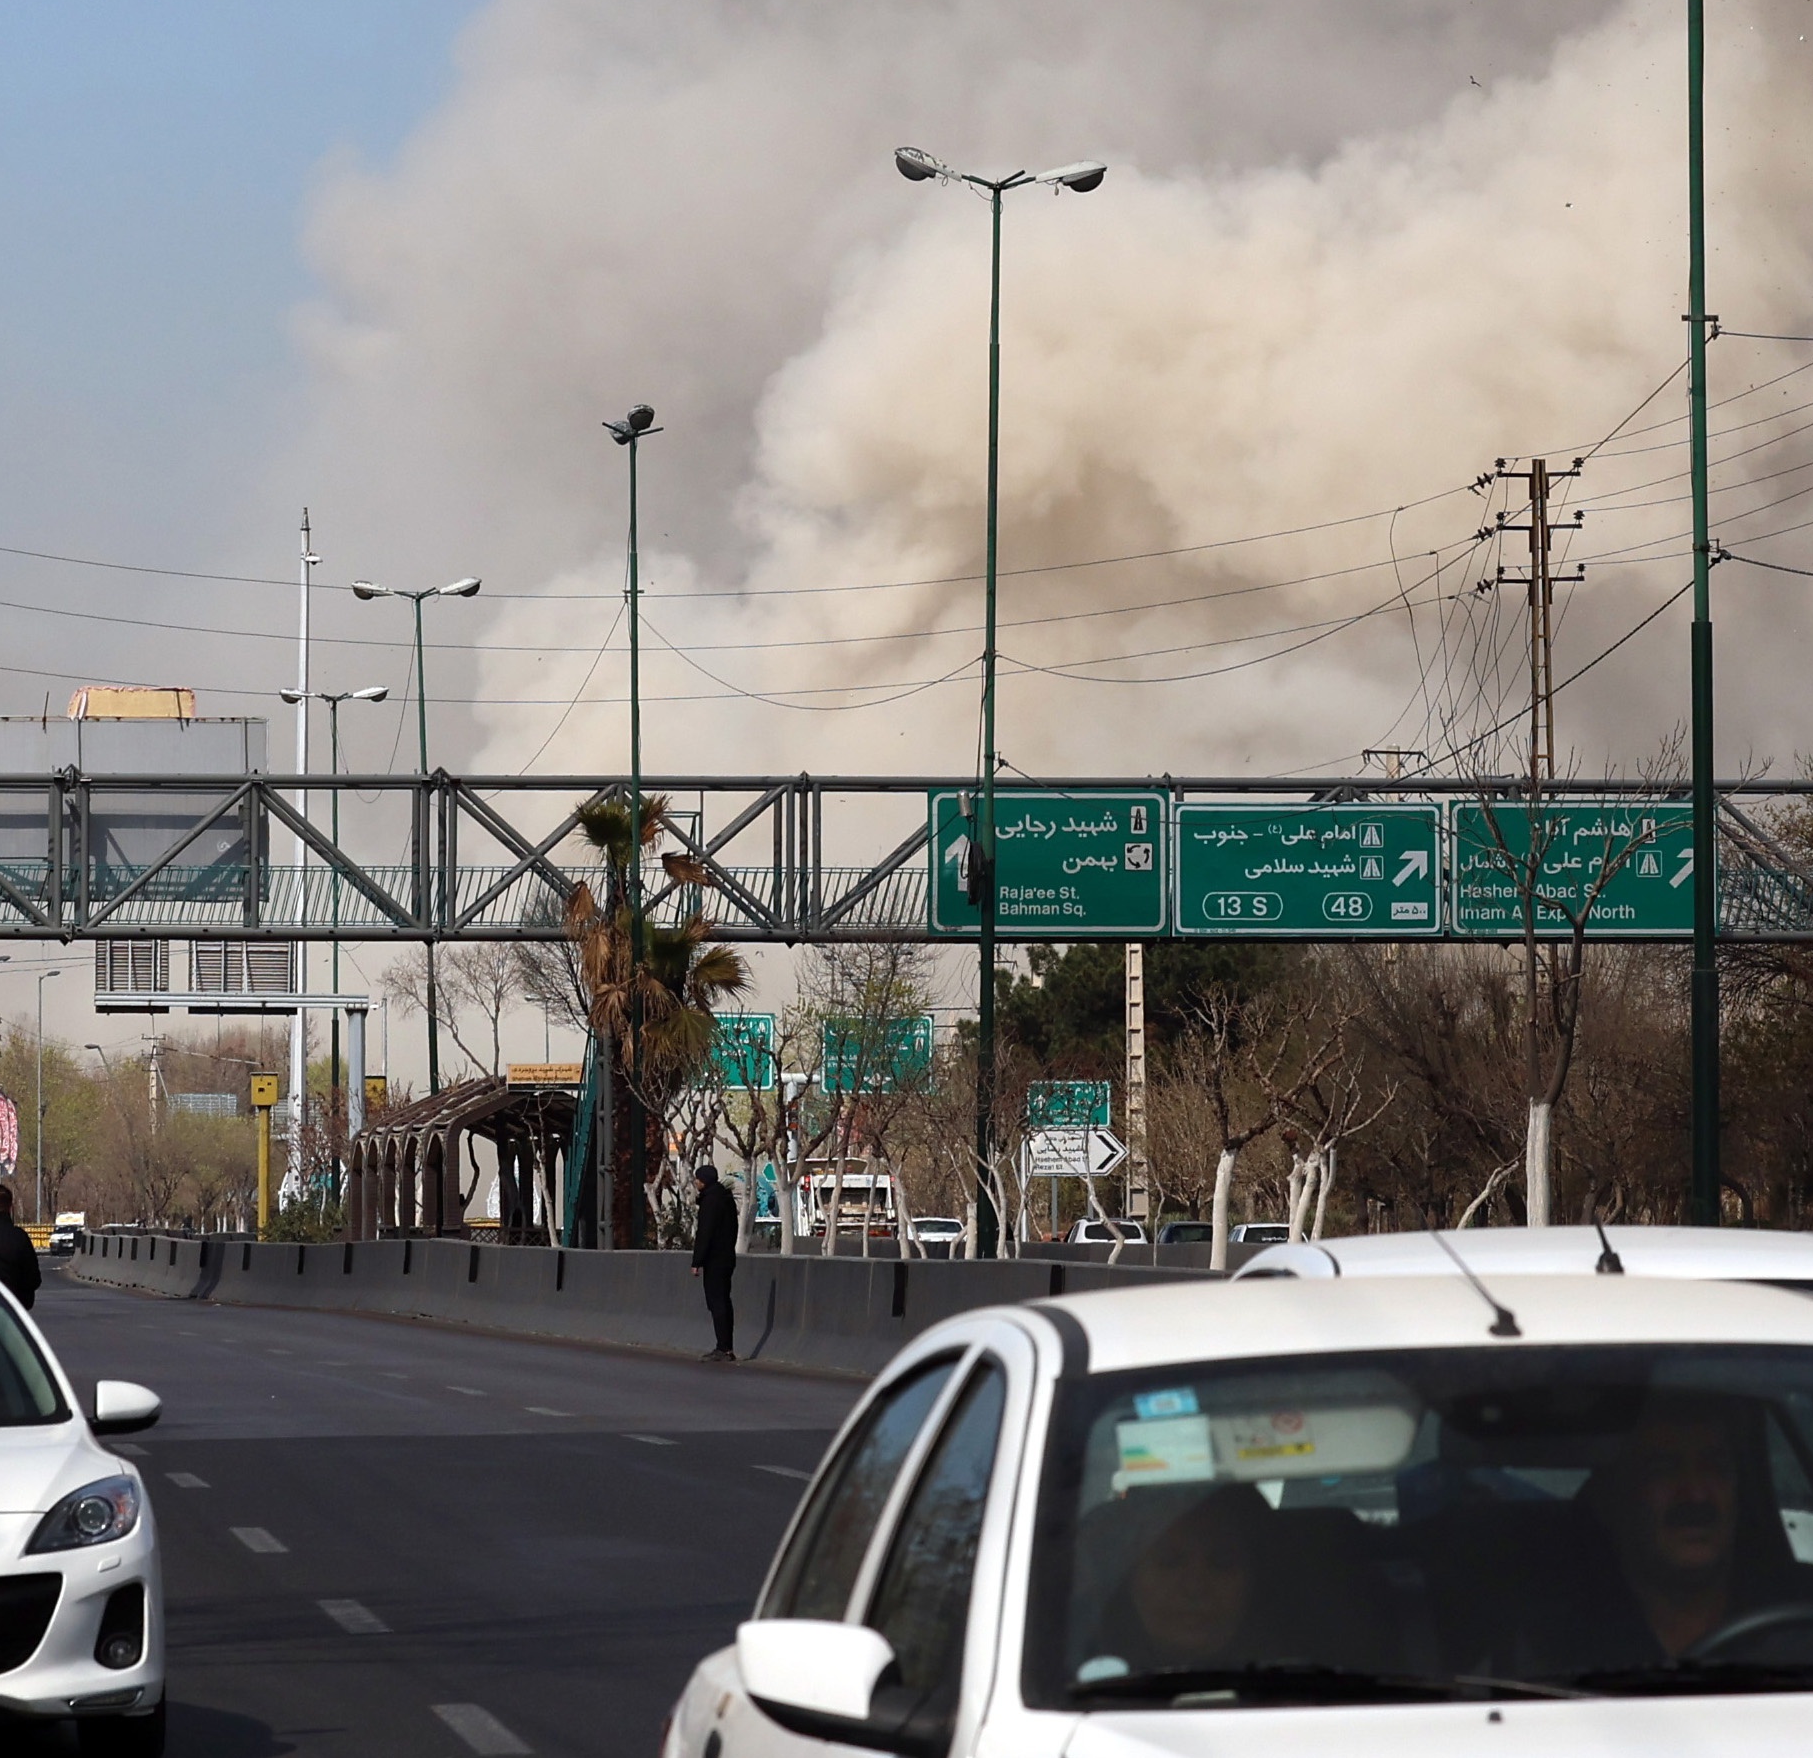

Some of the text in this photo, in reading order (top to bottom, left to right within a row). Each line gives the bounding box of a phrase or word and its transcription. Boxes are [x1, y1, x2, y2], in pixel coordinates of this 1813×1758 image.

[994, 811, 1118, 840] شهید رجایی
[1193, 824, 1249, 848] جنوب
[1573, 817, 1631, 846] هاشم
[1320, 825, 1356, 849] امام
[1062, 853, 1118, 874] بهمن
[1244, 854, 1356, 880] شهید سلامی
[999, 885, 1080, 902] Raja'ee St.
[999, 902, 1087, 918] Bahman Sq.
[1217, 896, 1268, 917] 13 S
[1330, 896, 1363, 917] 48
[1392, 905, 1411, 917] متر
[1460, 905, 1506, 920] Imam
[1589, 905, 1636, 920] North
